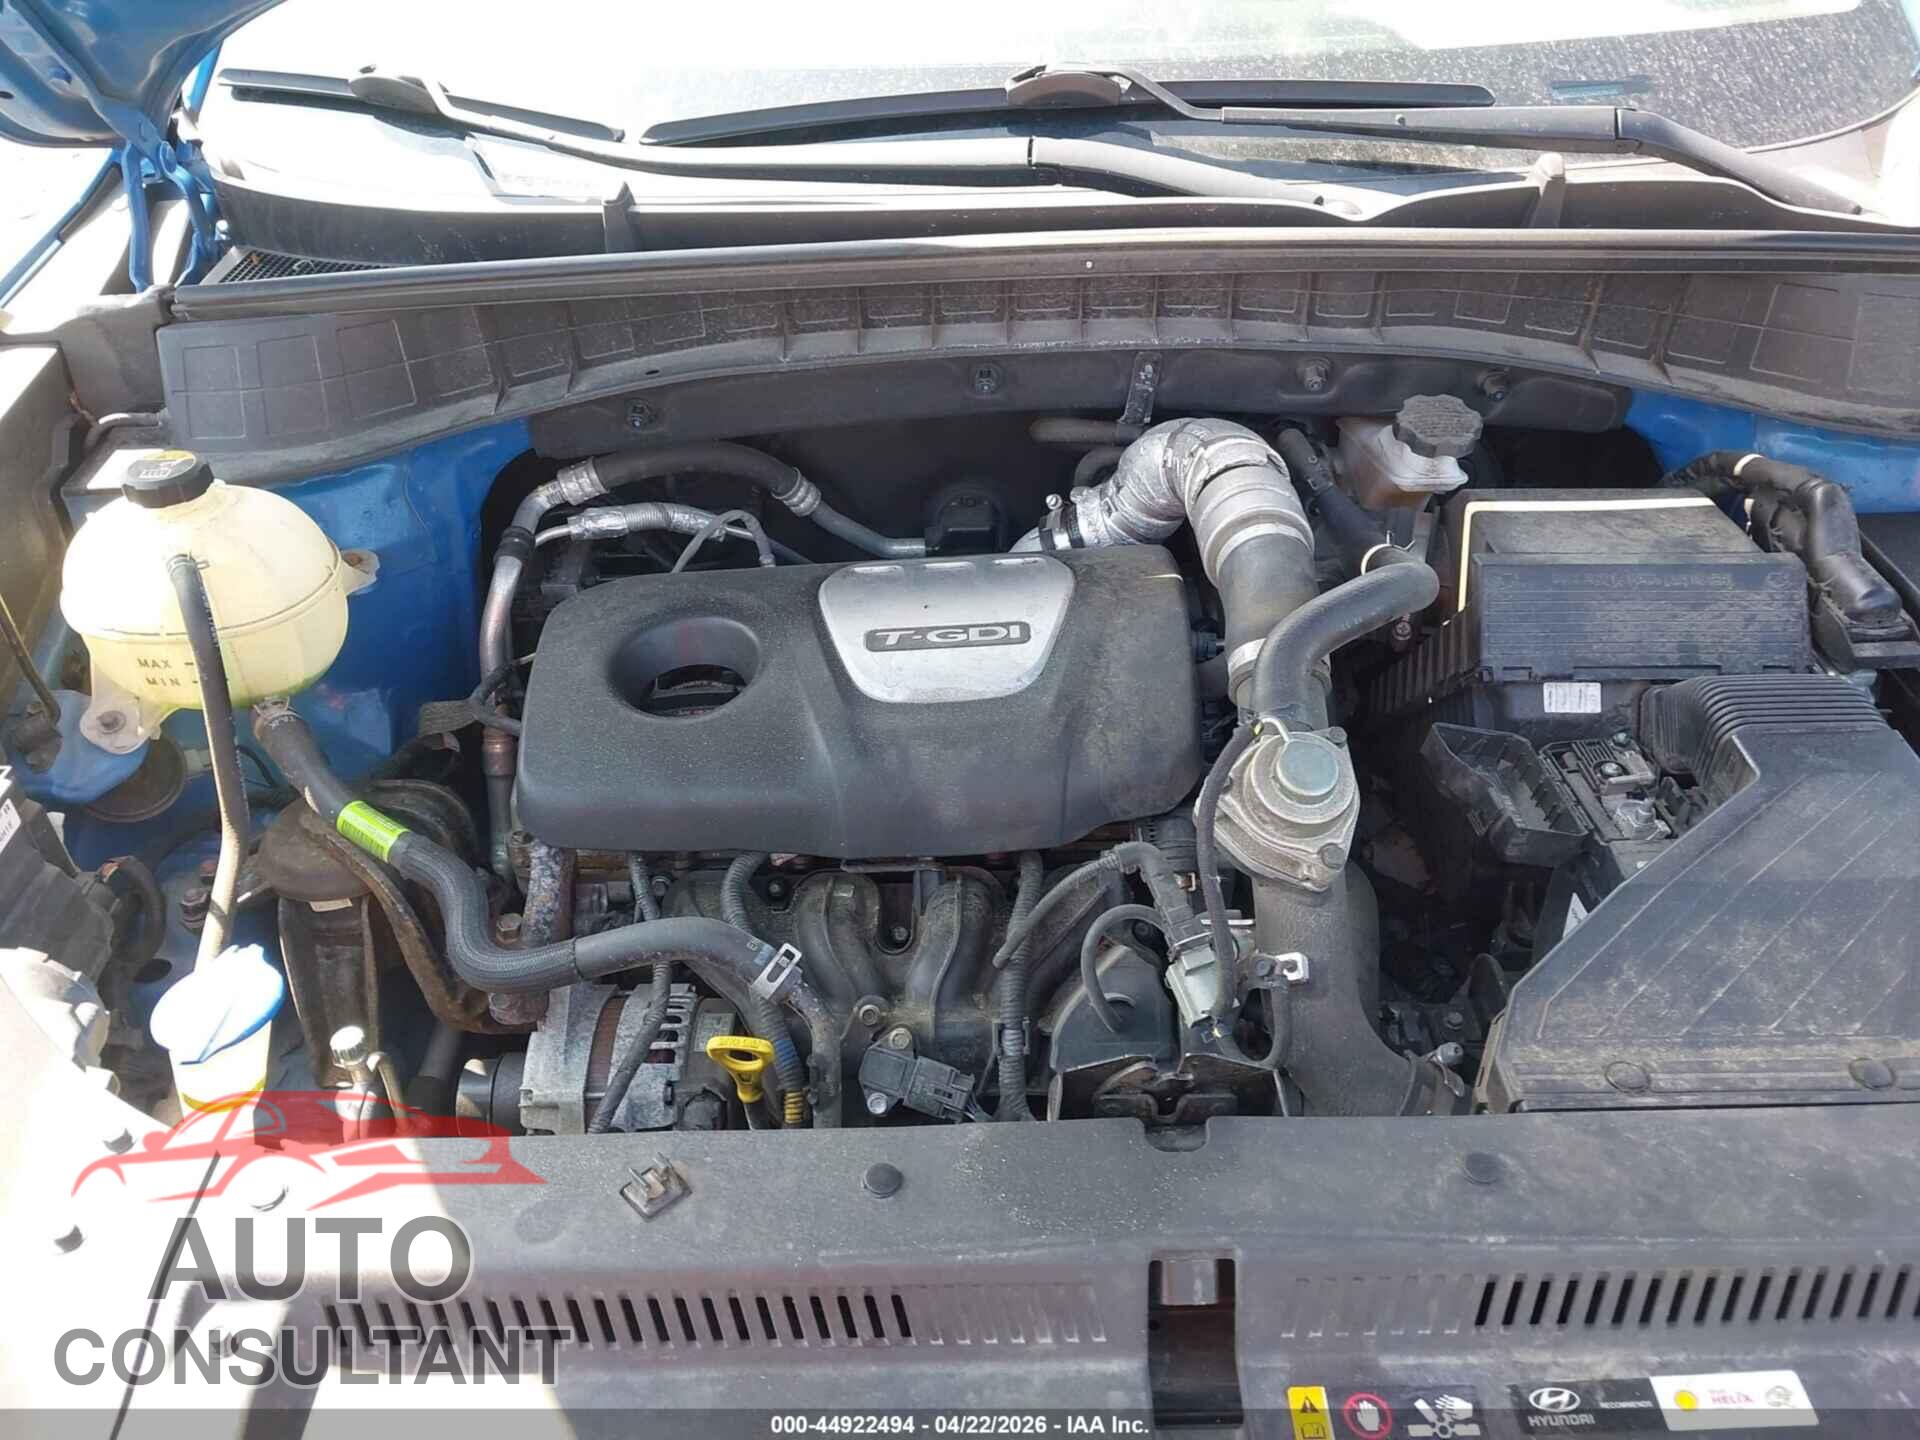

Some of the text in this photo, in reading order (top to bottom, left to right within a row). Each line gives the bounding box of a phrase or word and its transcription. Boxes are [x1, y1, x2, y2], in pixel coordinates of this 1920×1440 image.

[875, 624, 1022, 646] T-GDI
[137, 658, 172, 669] MAX
[145, 677, 181, 687] MIN
[1528, 1412, 1596, 1427] HYUNDAI
